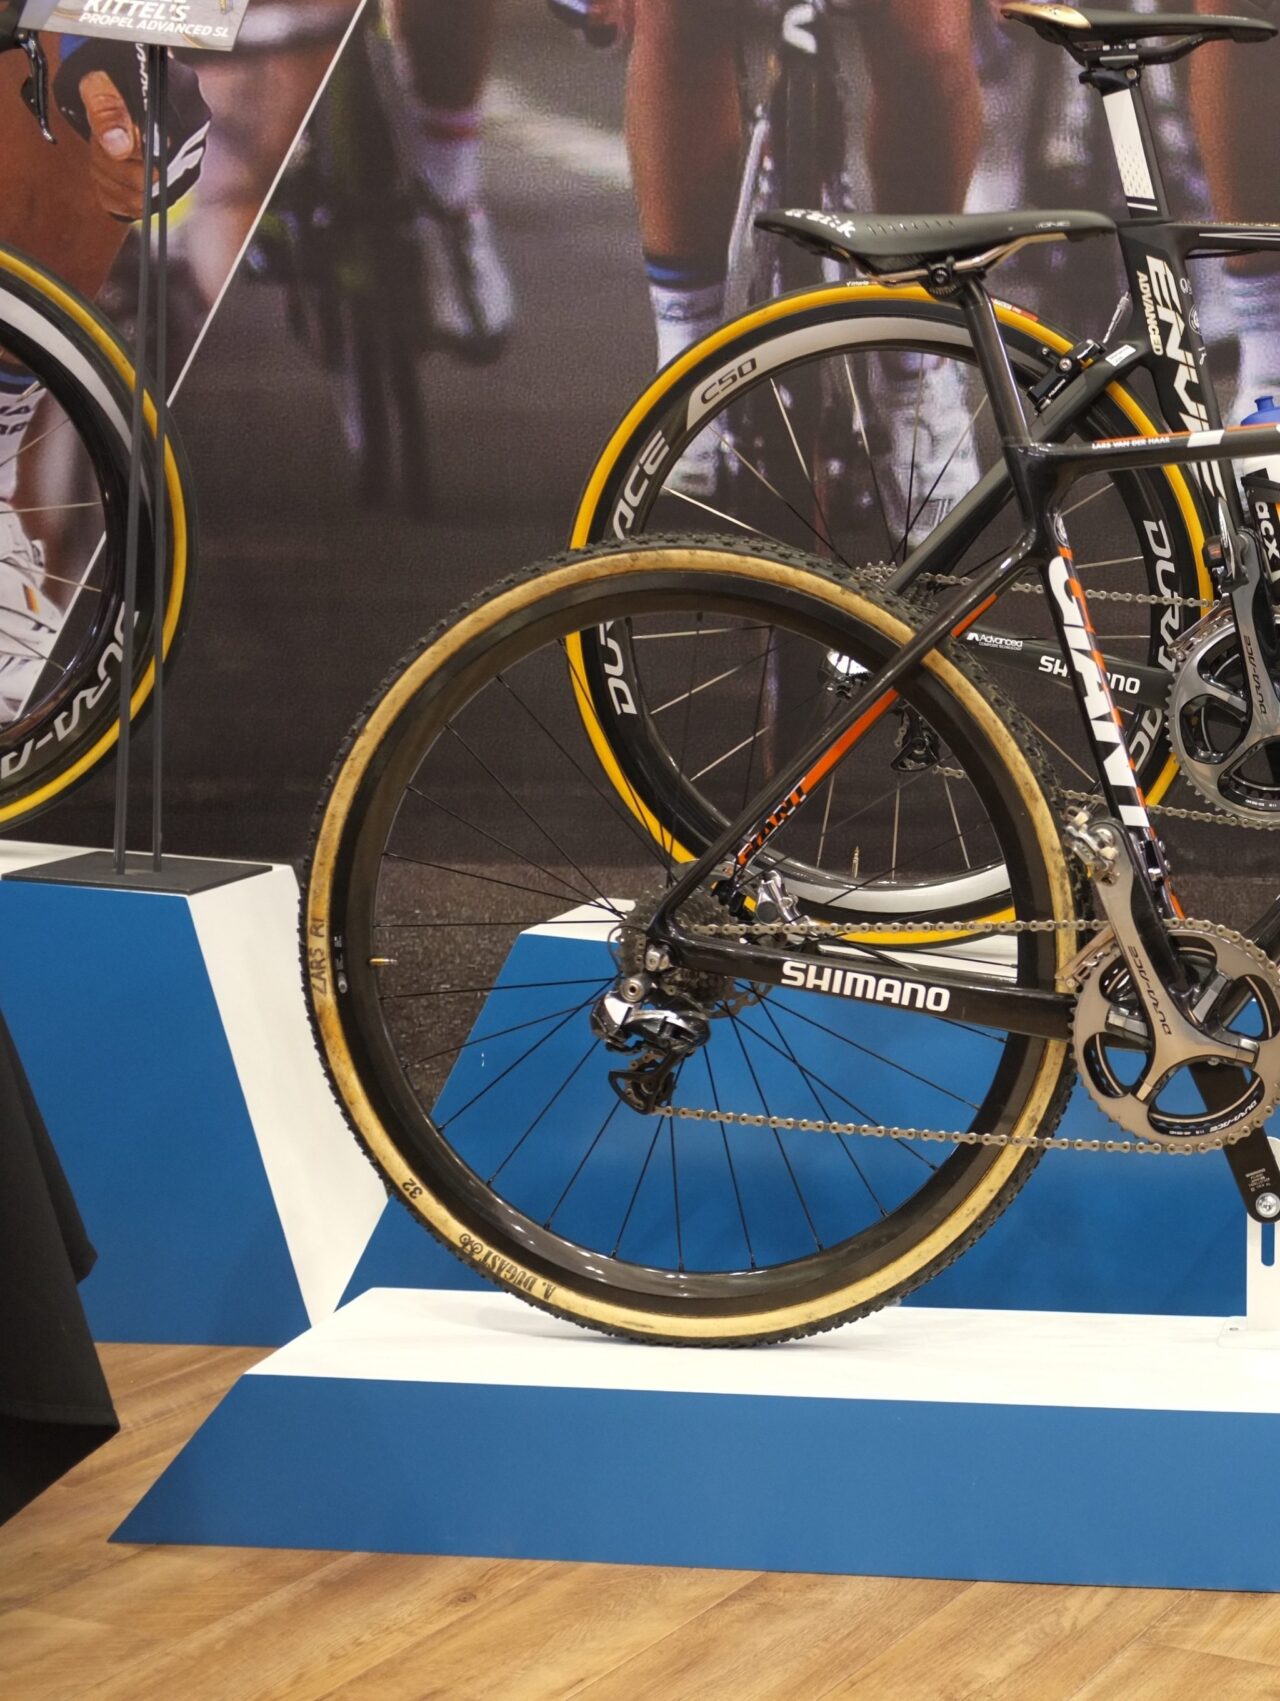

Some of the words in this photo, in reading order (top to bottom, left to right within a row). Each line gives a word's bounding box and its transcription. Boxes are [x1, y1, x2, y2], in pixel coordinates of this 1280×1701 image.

[79, 12, 134, 29] PROPEL
[136, 20, 212, 36] ADVANCED
[212, 26, 230, 38] SL
[83, 0, 190, 22] KITTEL'S
[1136, 270, 1163, 356] ADVANCED
[700, 357, 757, 406] C50
[1092, 442, 1112, 450] LARS
[1113, 440, 1130, 448] VAN
[1131, 438, 1147, 447] DER
[1148, 436, 1170, 445] HAAR
[1255, 500, 1280, 560] acx
[1048, 556, 1150, 827] GIANT
[309, 946, 327, 997] LARS
[781, 960, 950, 1012] SHIMANO
[1127, 945, 1172, 1035] DURA-ACE
[401, 1178, 423, 1199] 32
[478, 1251, 538, 1292] DUGAST
